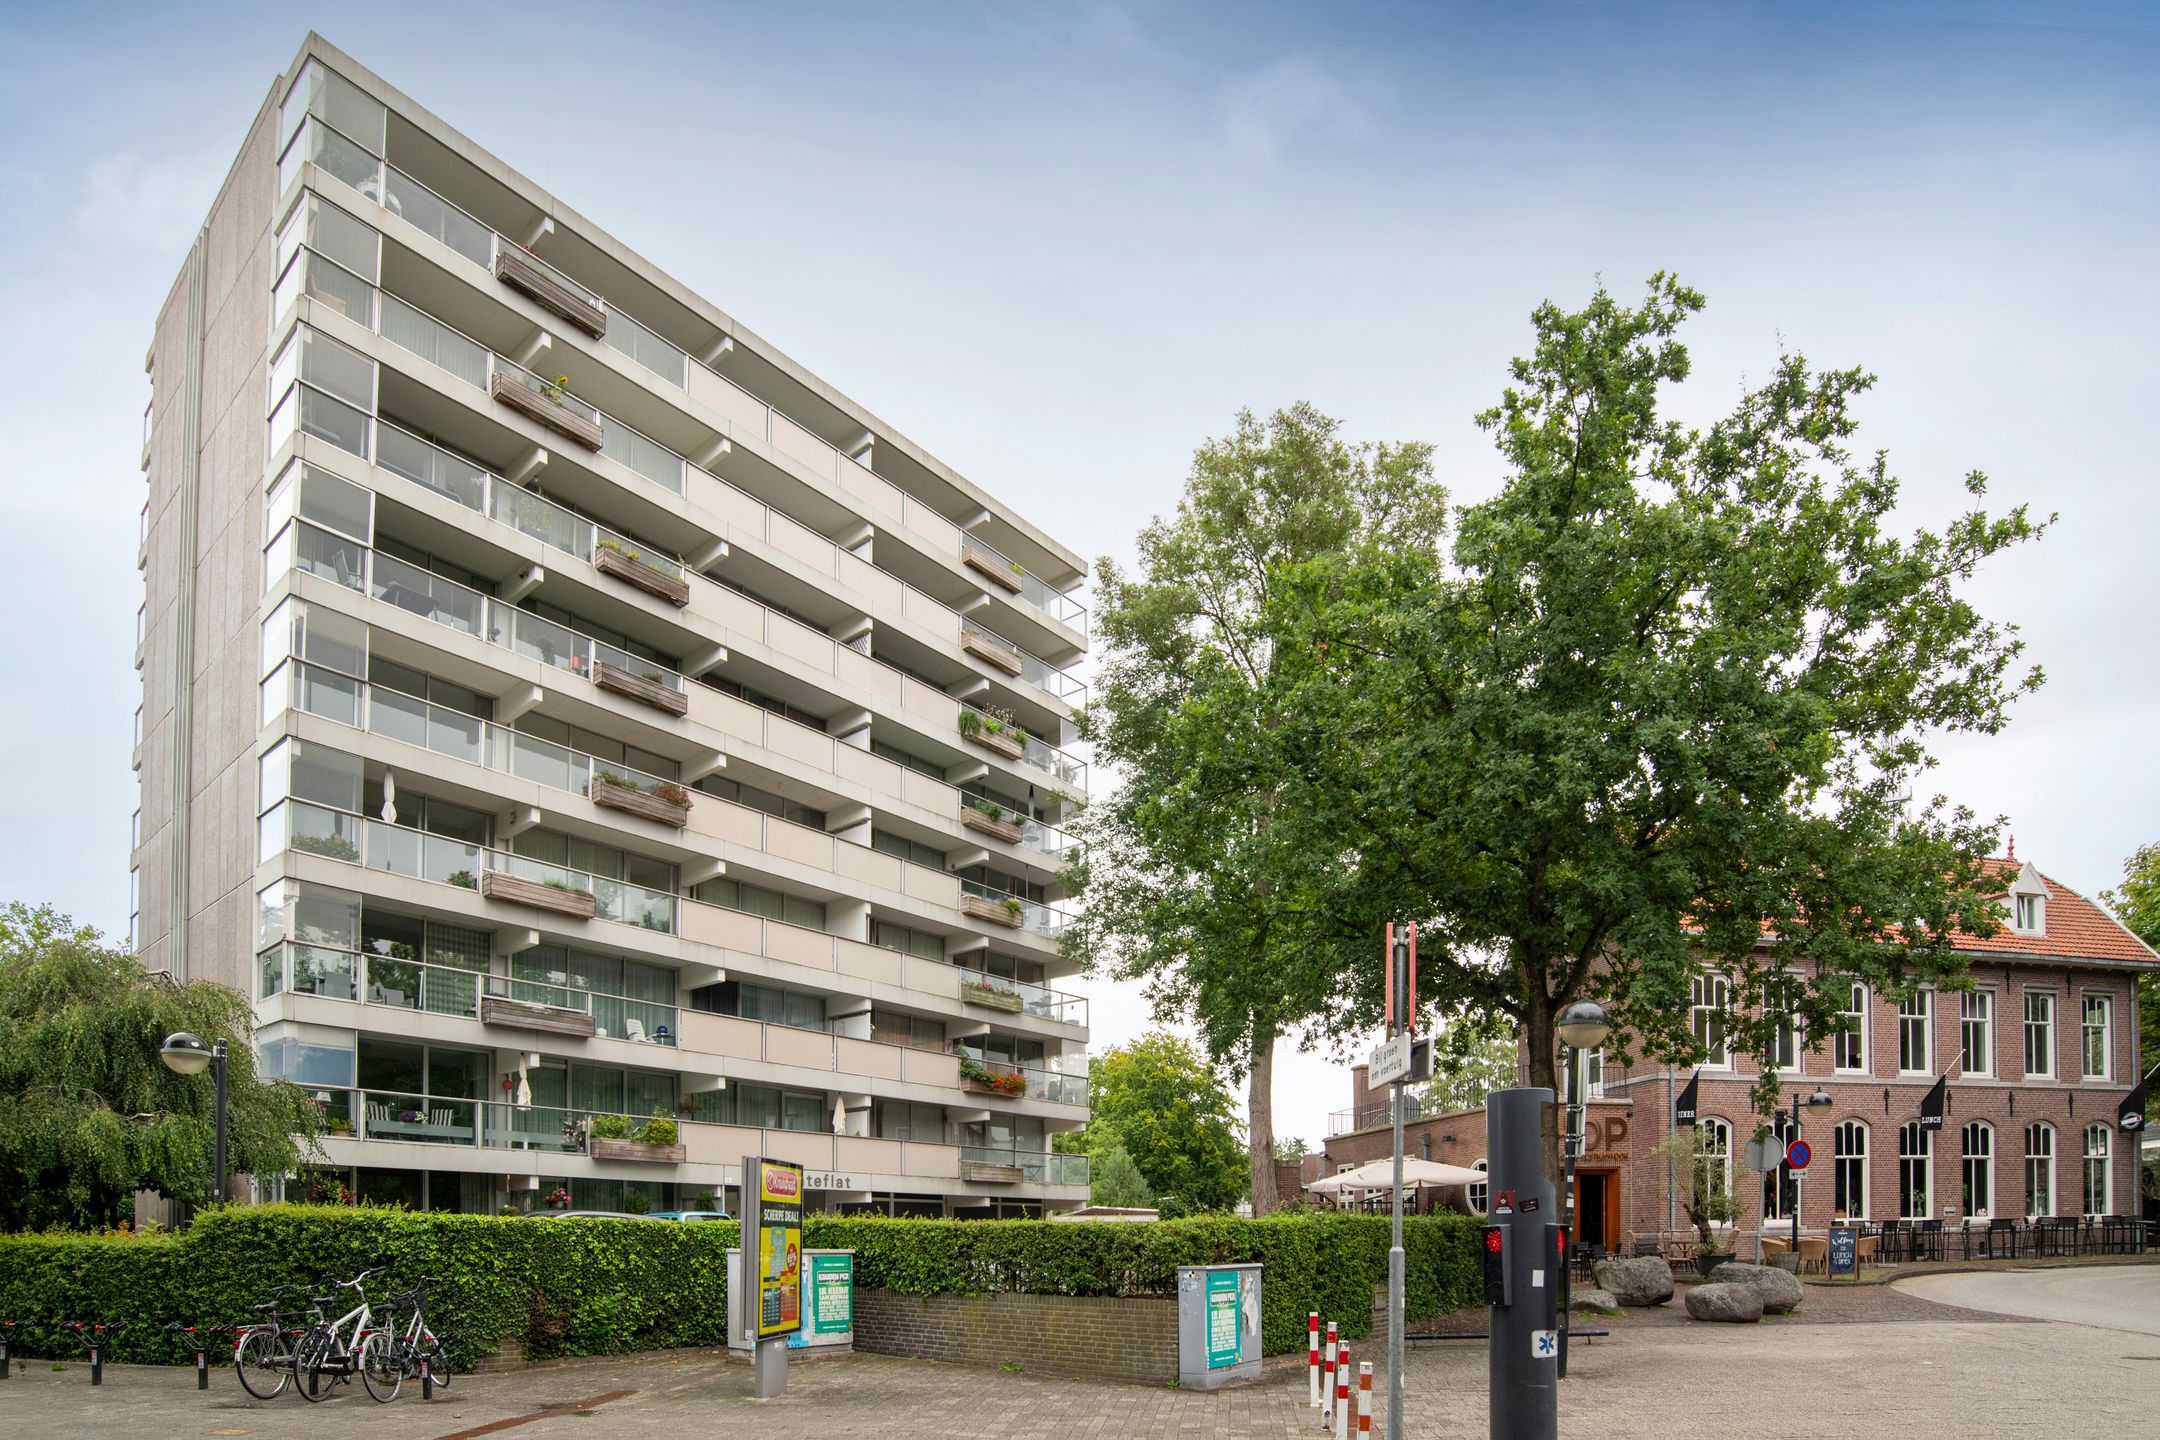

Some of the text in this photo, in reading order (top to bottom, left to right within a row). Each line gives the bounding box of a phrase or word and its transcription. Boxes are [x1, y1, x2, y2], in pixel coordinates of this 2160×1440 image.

[1380, 1058, 1402, 1076] voertuig
[763, 1208, 800, 1223] SCHERPE DEAL!
